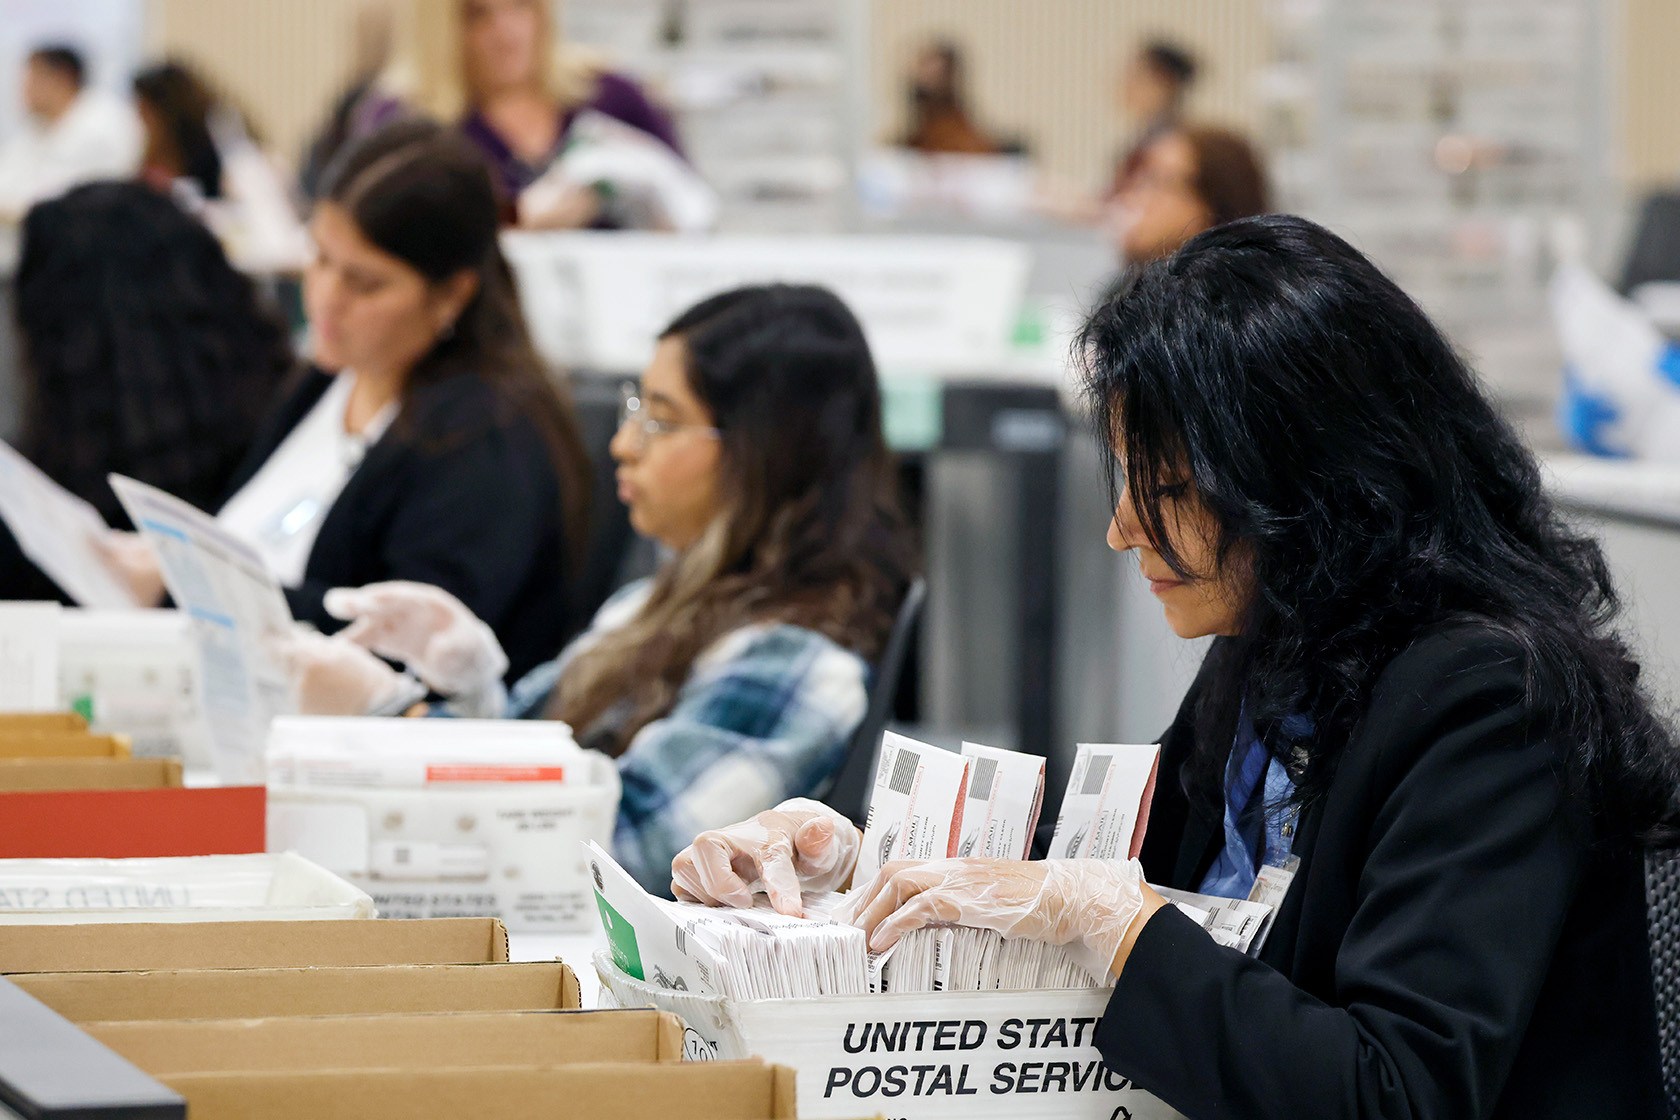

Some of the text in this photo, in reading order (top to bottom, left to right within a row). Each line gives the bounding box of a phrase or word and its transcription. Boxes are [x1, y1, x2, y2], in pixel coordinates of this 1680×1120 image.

[843, 1019, 988, 1054] UNITED
[823, 1060, 1146, 1098] POSTAL SERVIC
